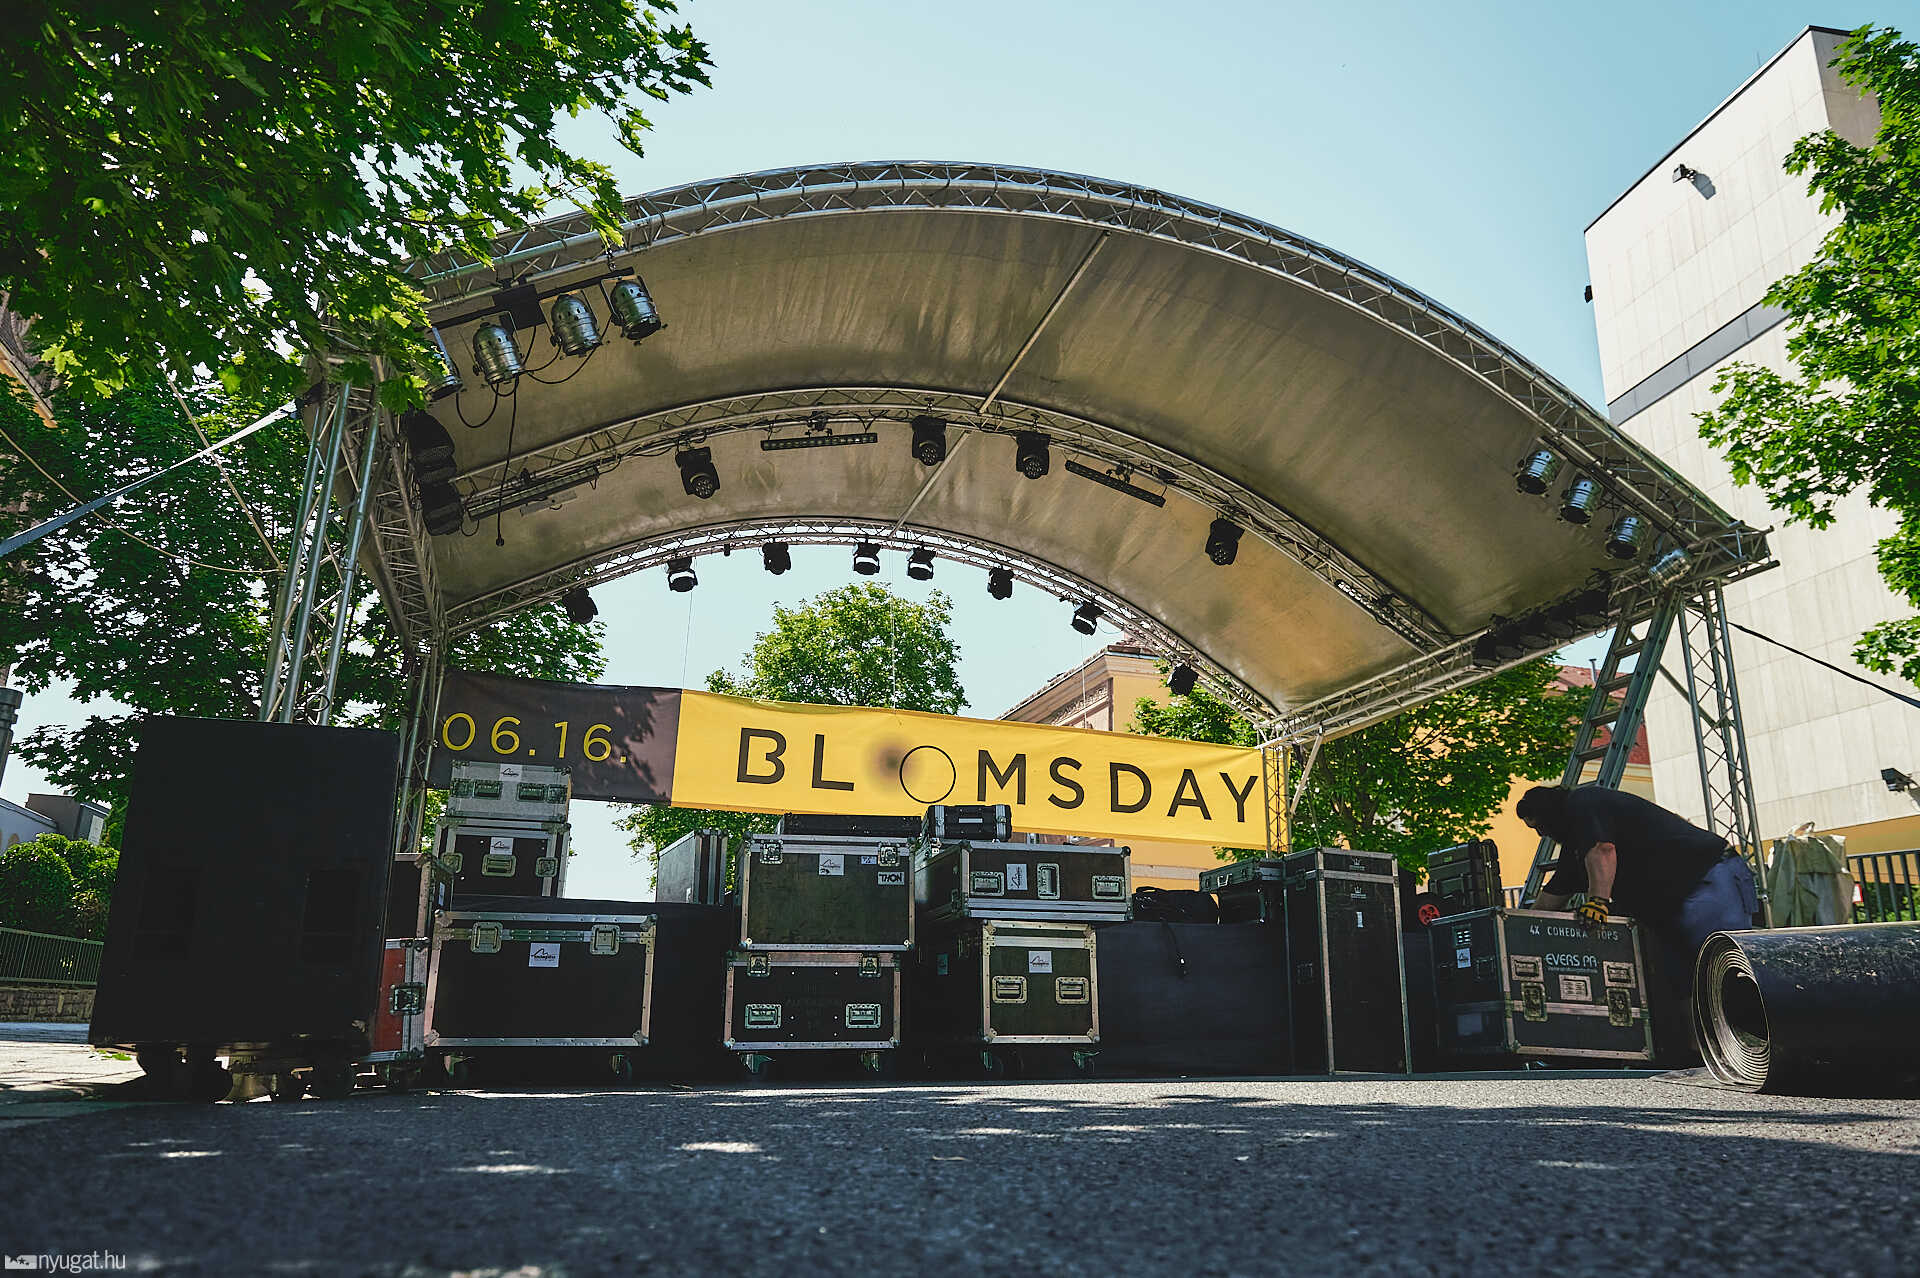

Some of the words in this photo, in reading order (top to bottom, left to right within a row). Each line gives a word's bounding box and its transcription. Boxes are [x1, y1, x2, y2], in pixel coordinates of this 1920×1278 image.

[442, 711, 628, 764] 06.16.
[737, 727, 1259, 823] BLOMSDAY
[878, 873, 902, 883] THON
[1545, 953, 1581, 967] EVERS
